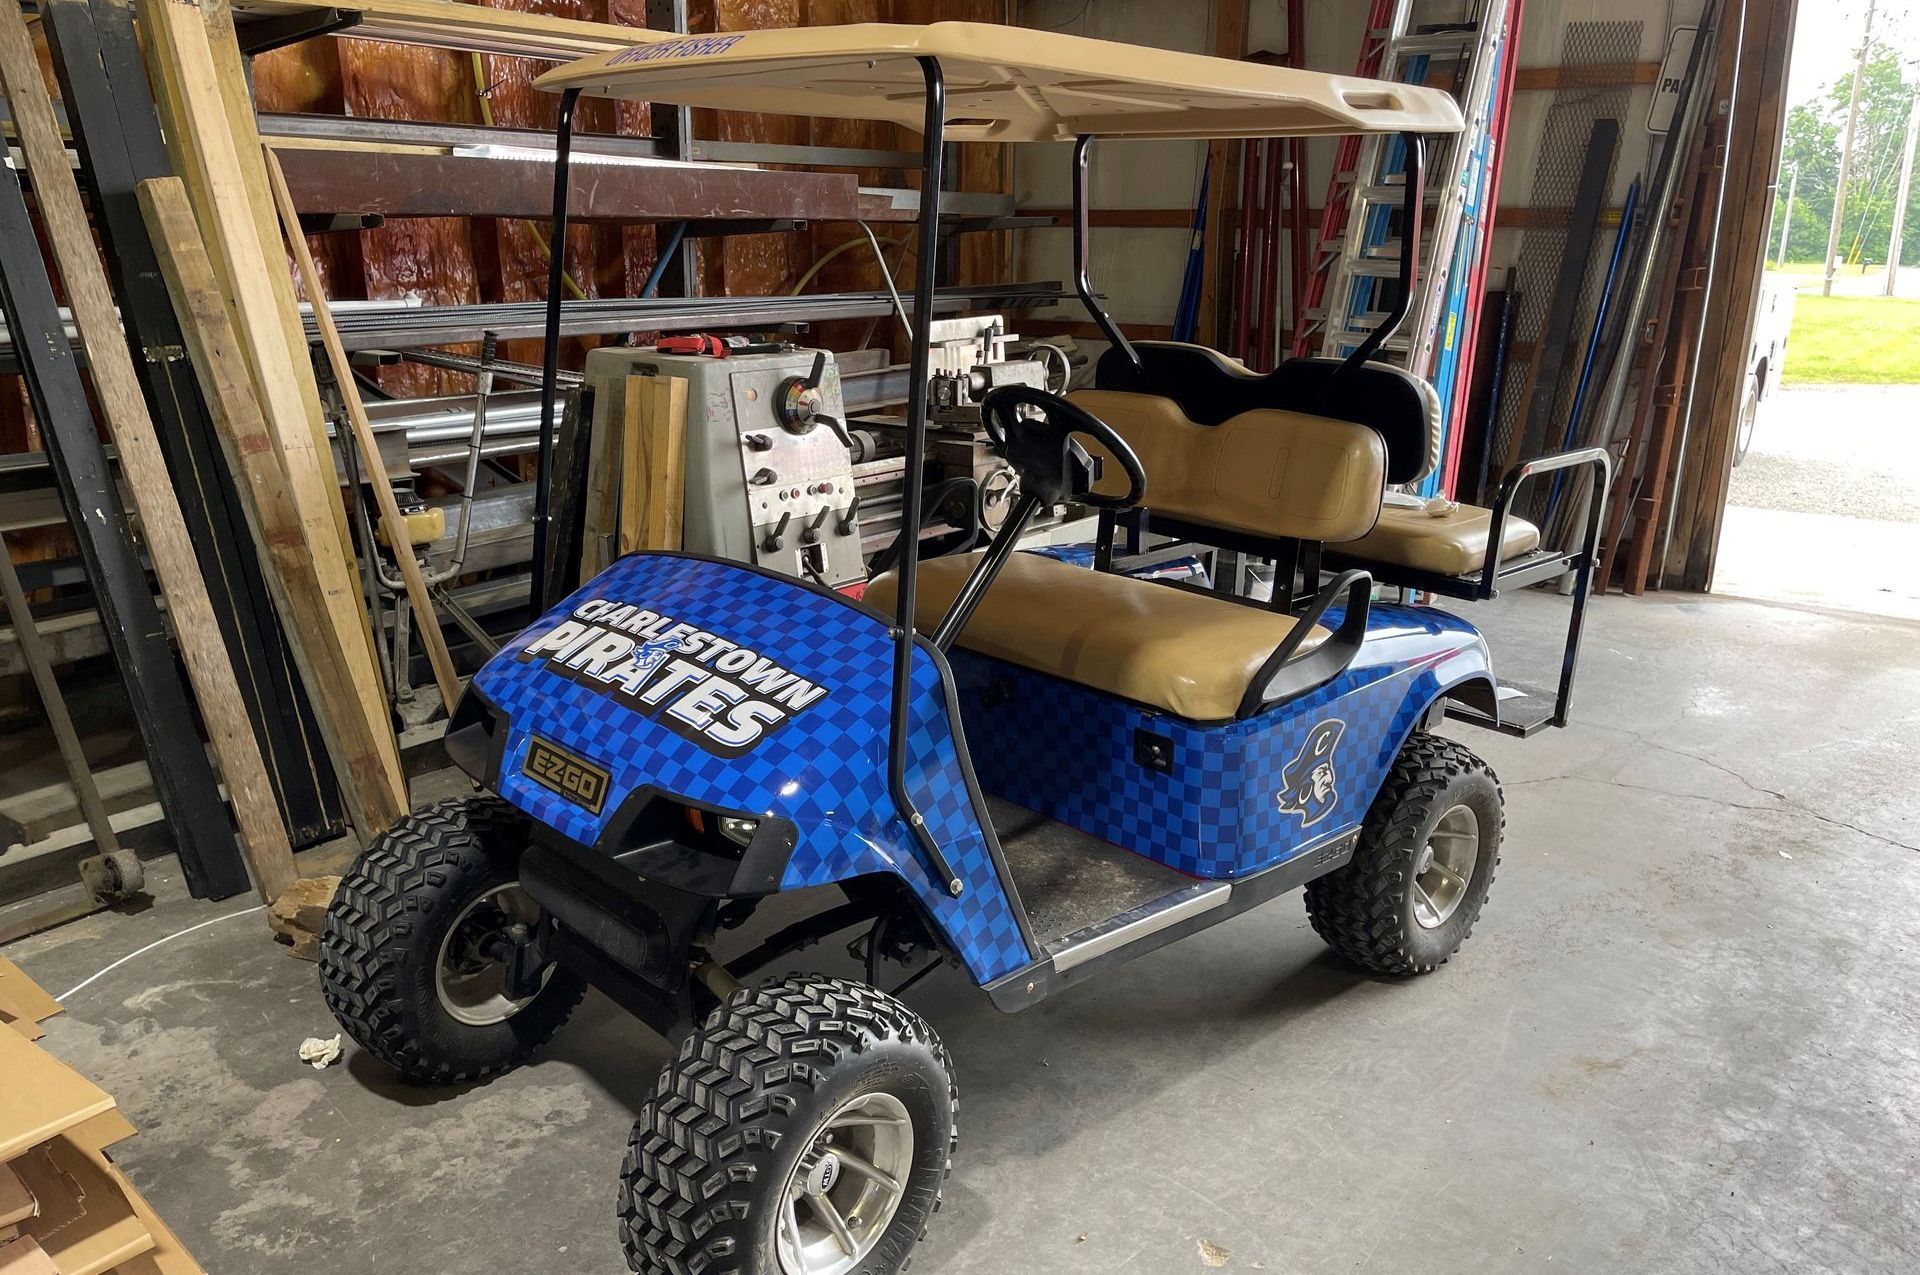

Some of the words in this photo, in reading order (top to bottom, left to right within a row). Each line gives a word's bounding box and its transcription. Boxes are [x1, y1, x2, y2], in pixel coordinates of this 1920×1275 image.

[665, 35, 746, 58] FISHER
[573, 599, 828, 711] CHARLESTOWN
[524, 620, 786, 747] PIRATES
[1314, 731, 1331, 756] C
[532, 748, 598, 800] EZGO
